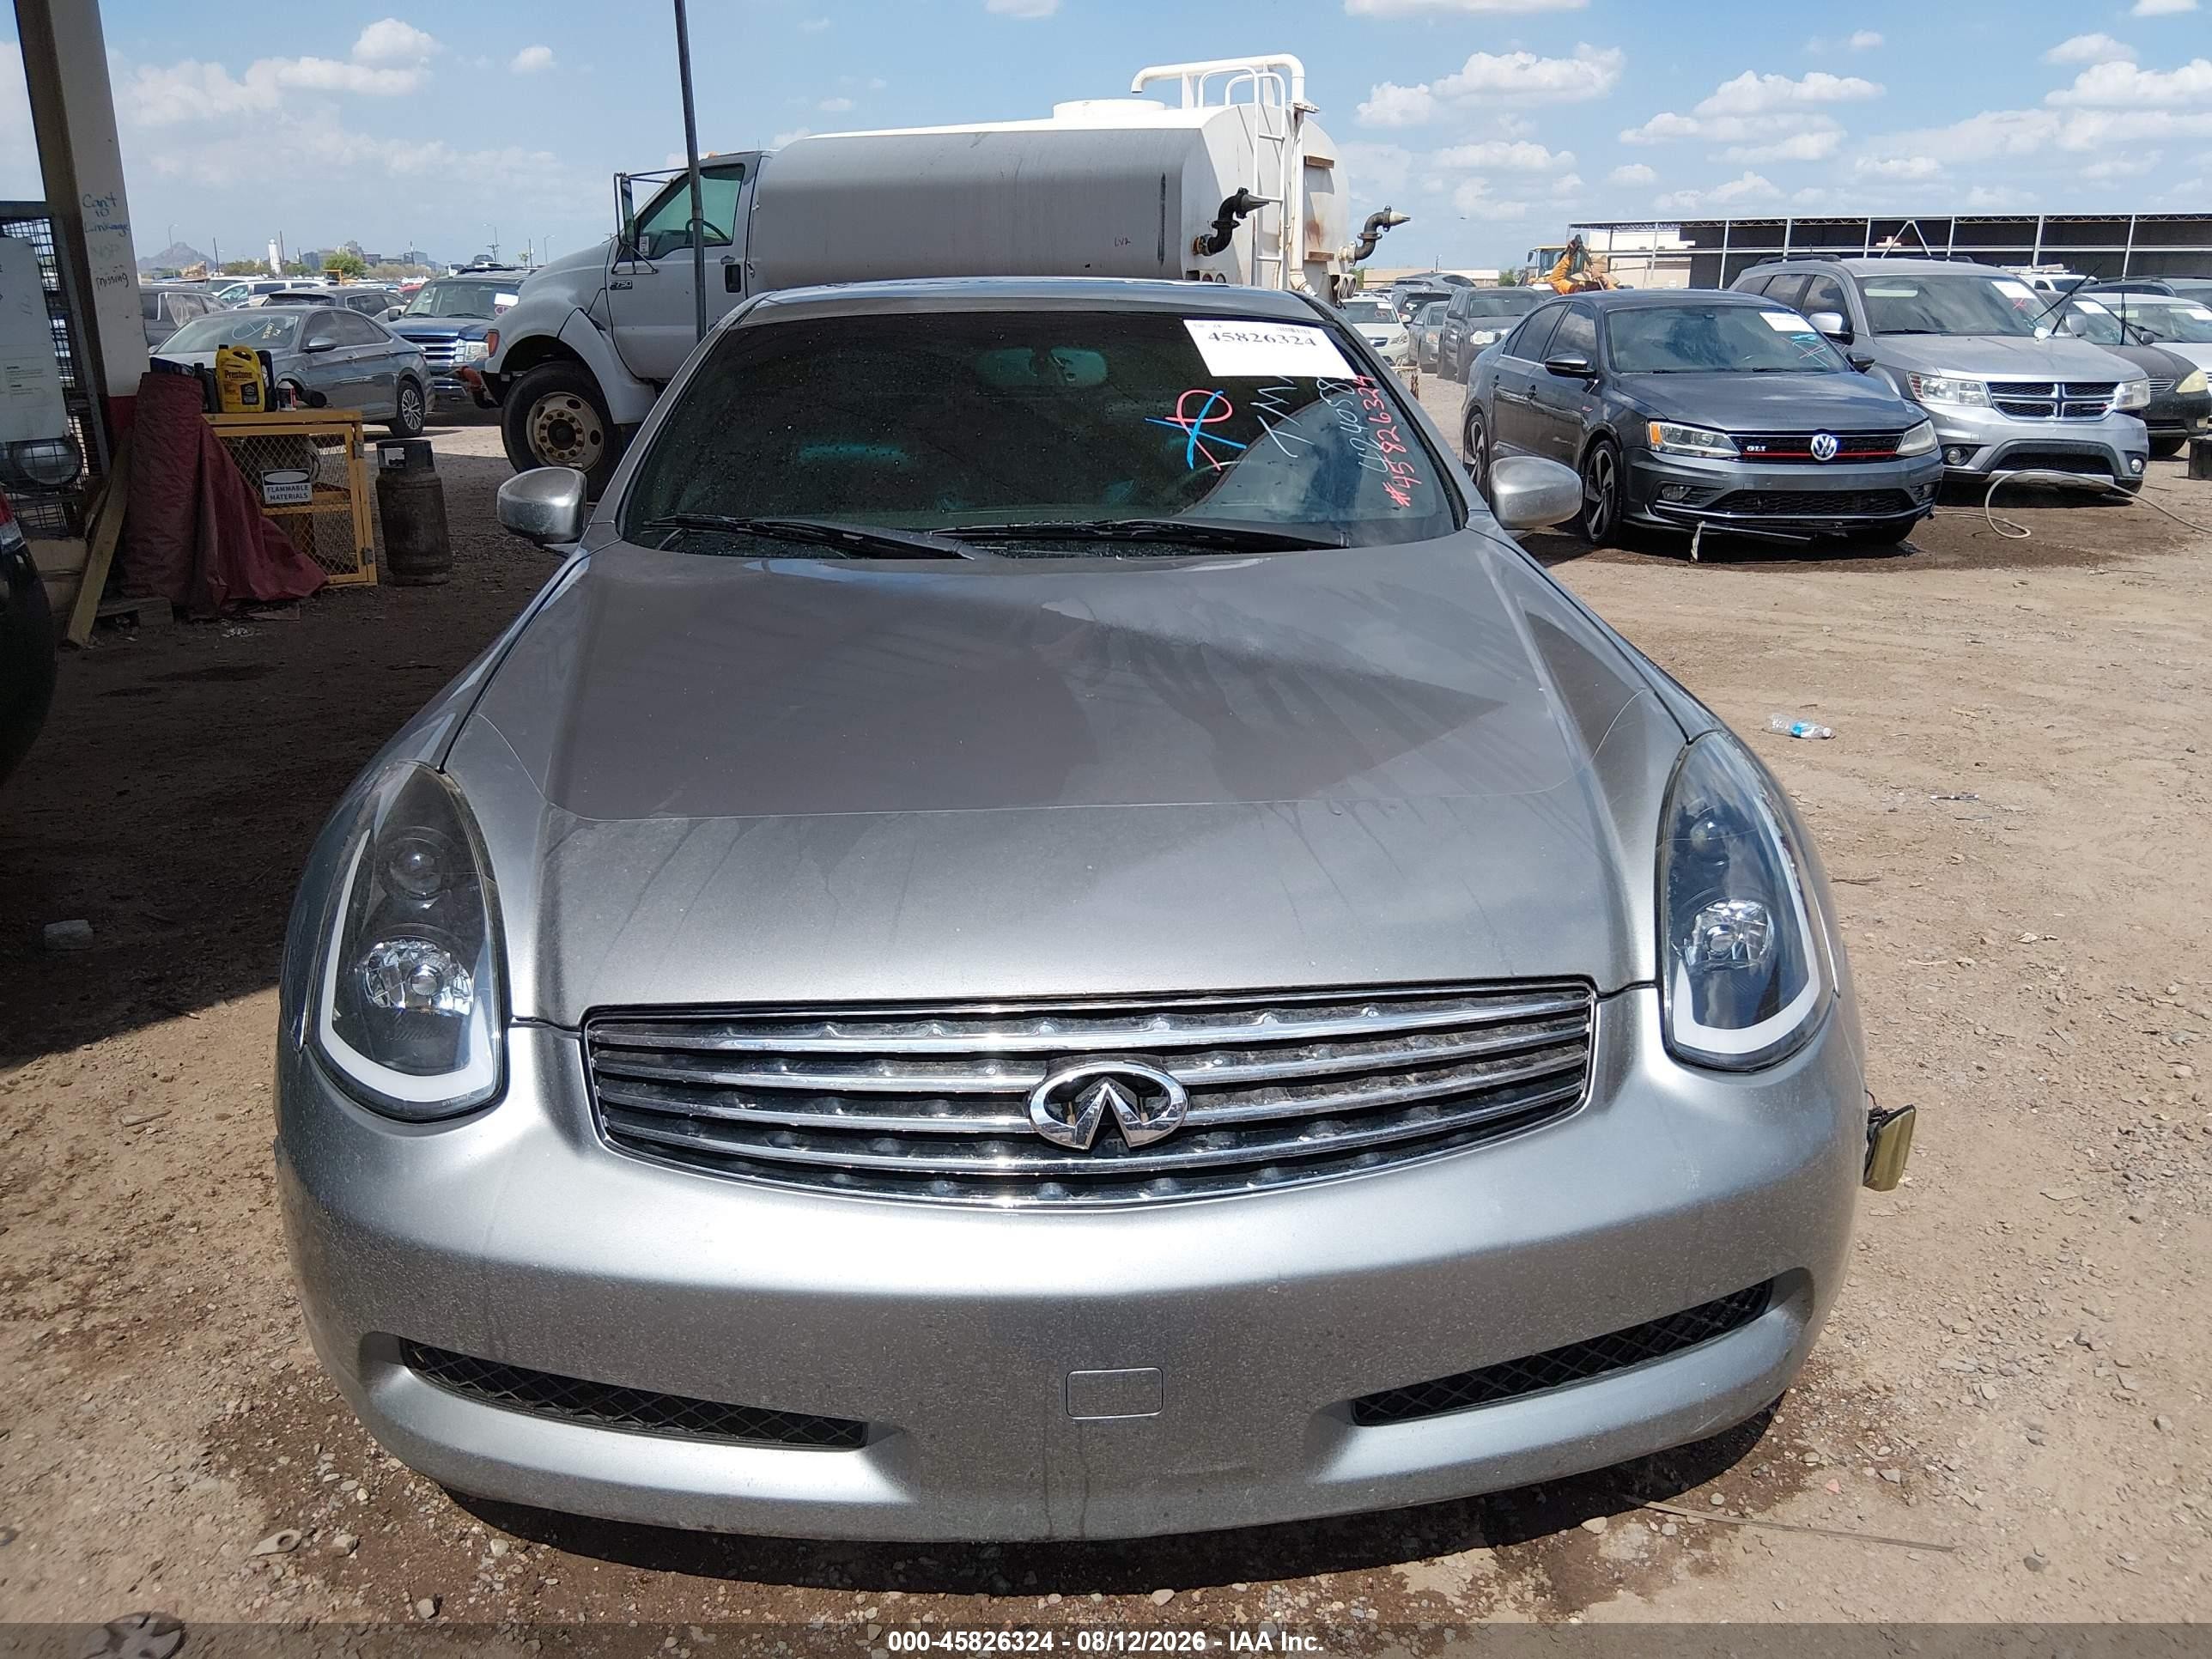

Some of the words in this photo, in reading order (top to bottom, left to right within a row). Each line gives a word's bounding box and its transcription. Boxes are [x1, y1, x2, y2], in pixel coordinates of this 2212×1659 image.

[1208, 331, 1317, 346] 45826324
[1352, 374, 1422, 507] #45826324
[266, 484, 309, 493] FLAMMABLE
[270, 492, 308, 501] MATERIALS
